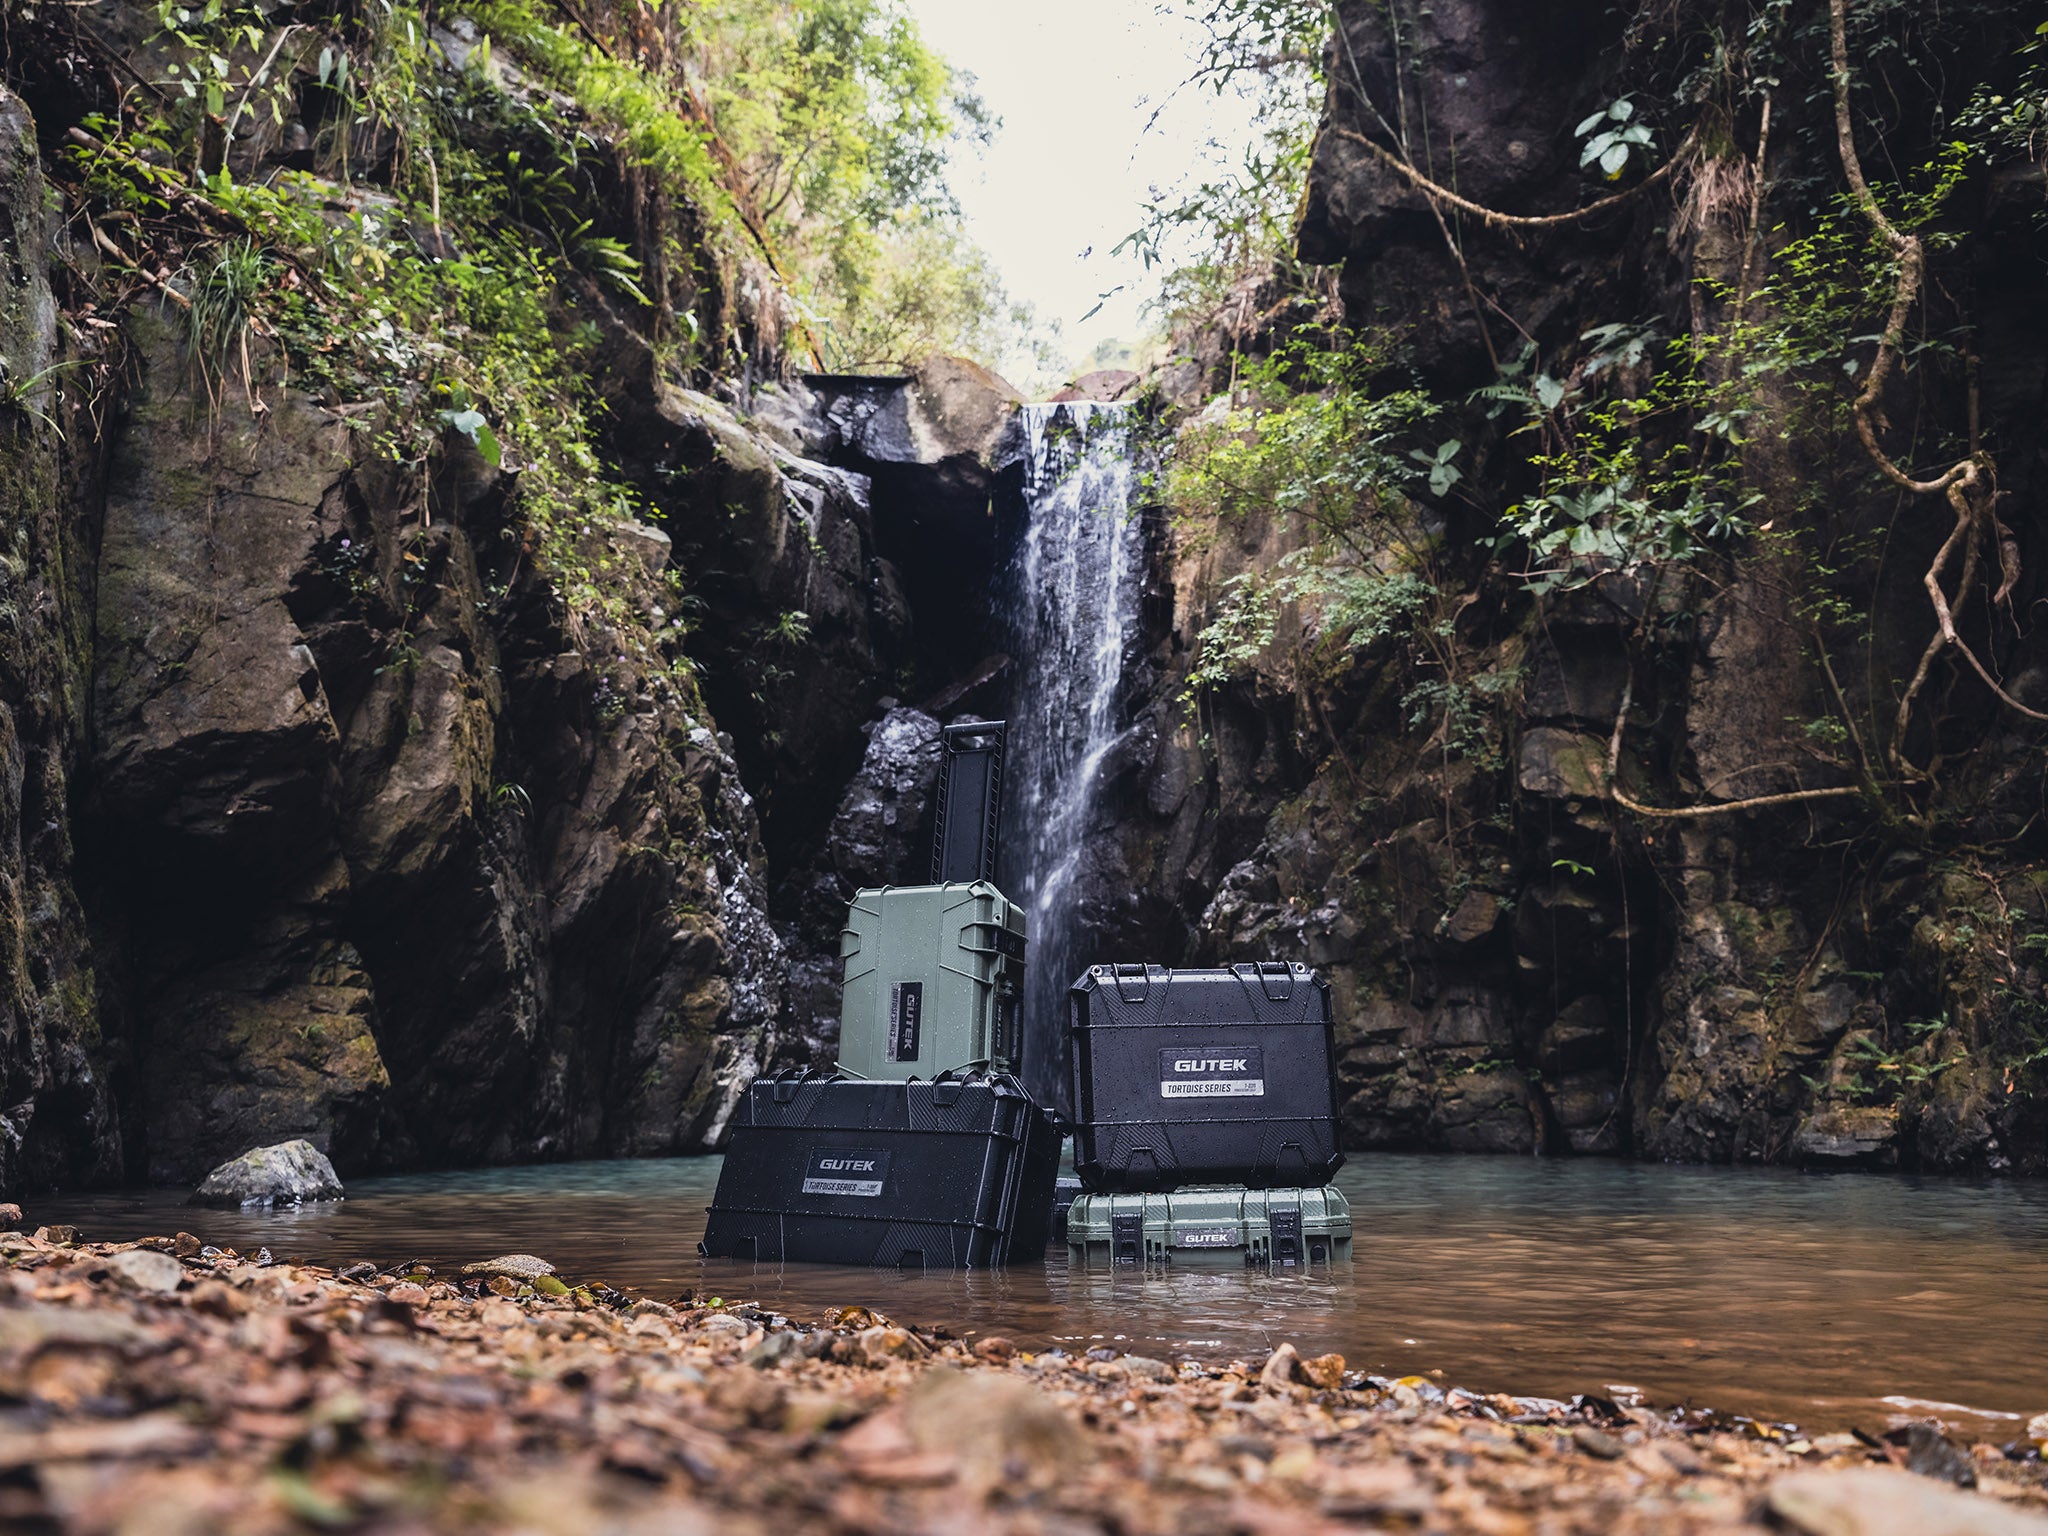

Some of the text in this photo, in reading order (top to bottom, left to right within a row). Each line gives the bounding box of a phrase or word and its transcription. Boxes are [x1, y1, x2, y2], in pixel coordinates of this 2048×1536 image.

[891, 988, 899, 1015] TORTOISE
[889, 1015, 897, 1038] SERIES
[904, 994, 915, 1050] GUTEK
[1174, 1059, 1247, 1072] GUTEK
[1168, 1084, 1203, 1094] TORTOISE
[1204, 1083, 1232, 1093] SERIES
[820, 1159, 875, 1171] GUTEK
[808, 1181, 836, 1191] TORTOISE
[835, 1182, 858, 1192] SERIES
[1185, 1234, 1228, 1243] GUTEK
